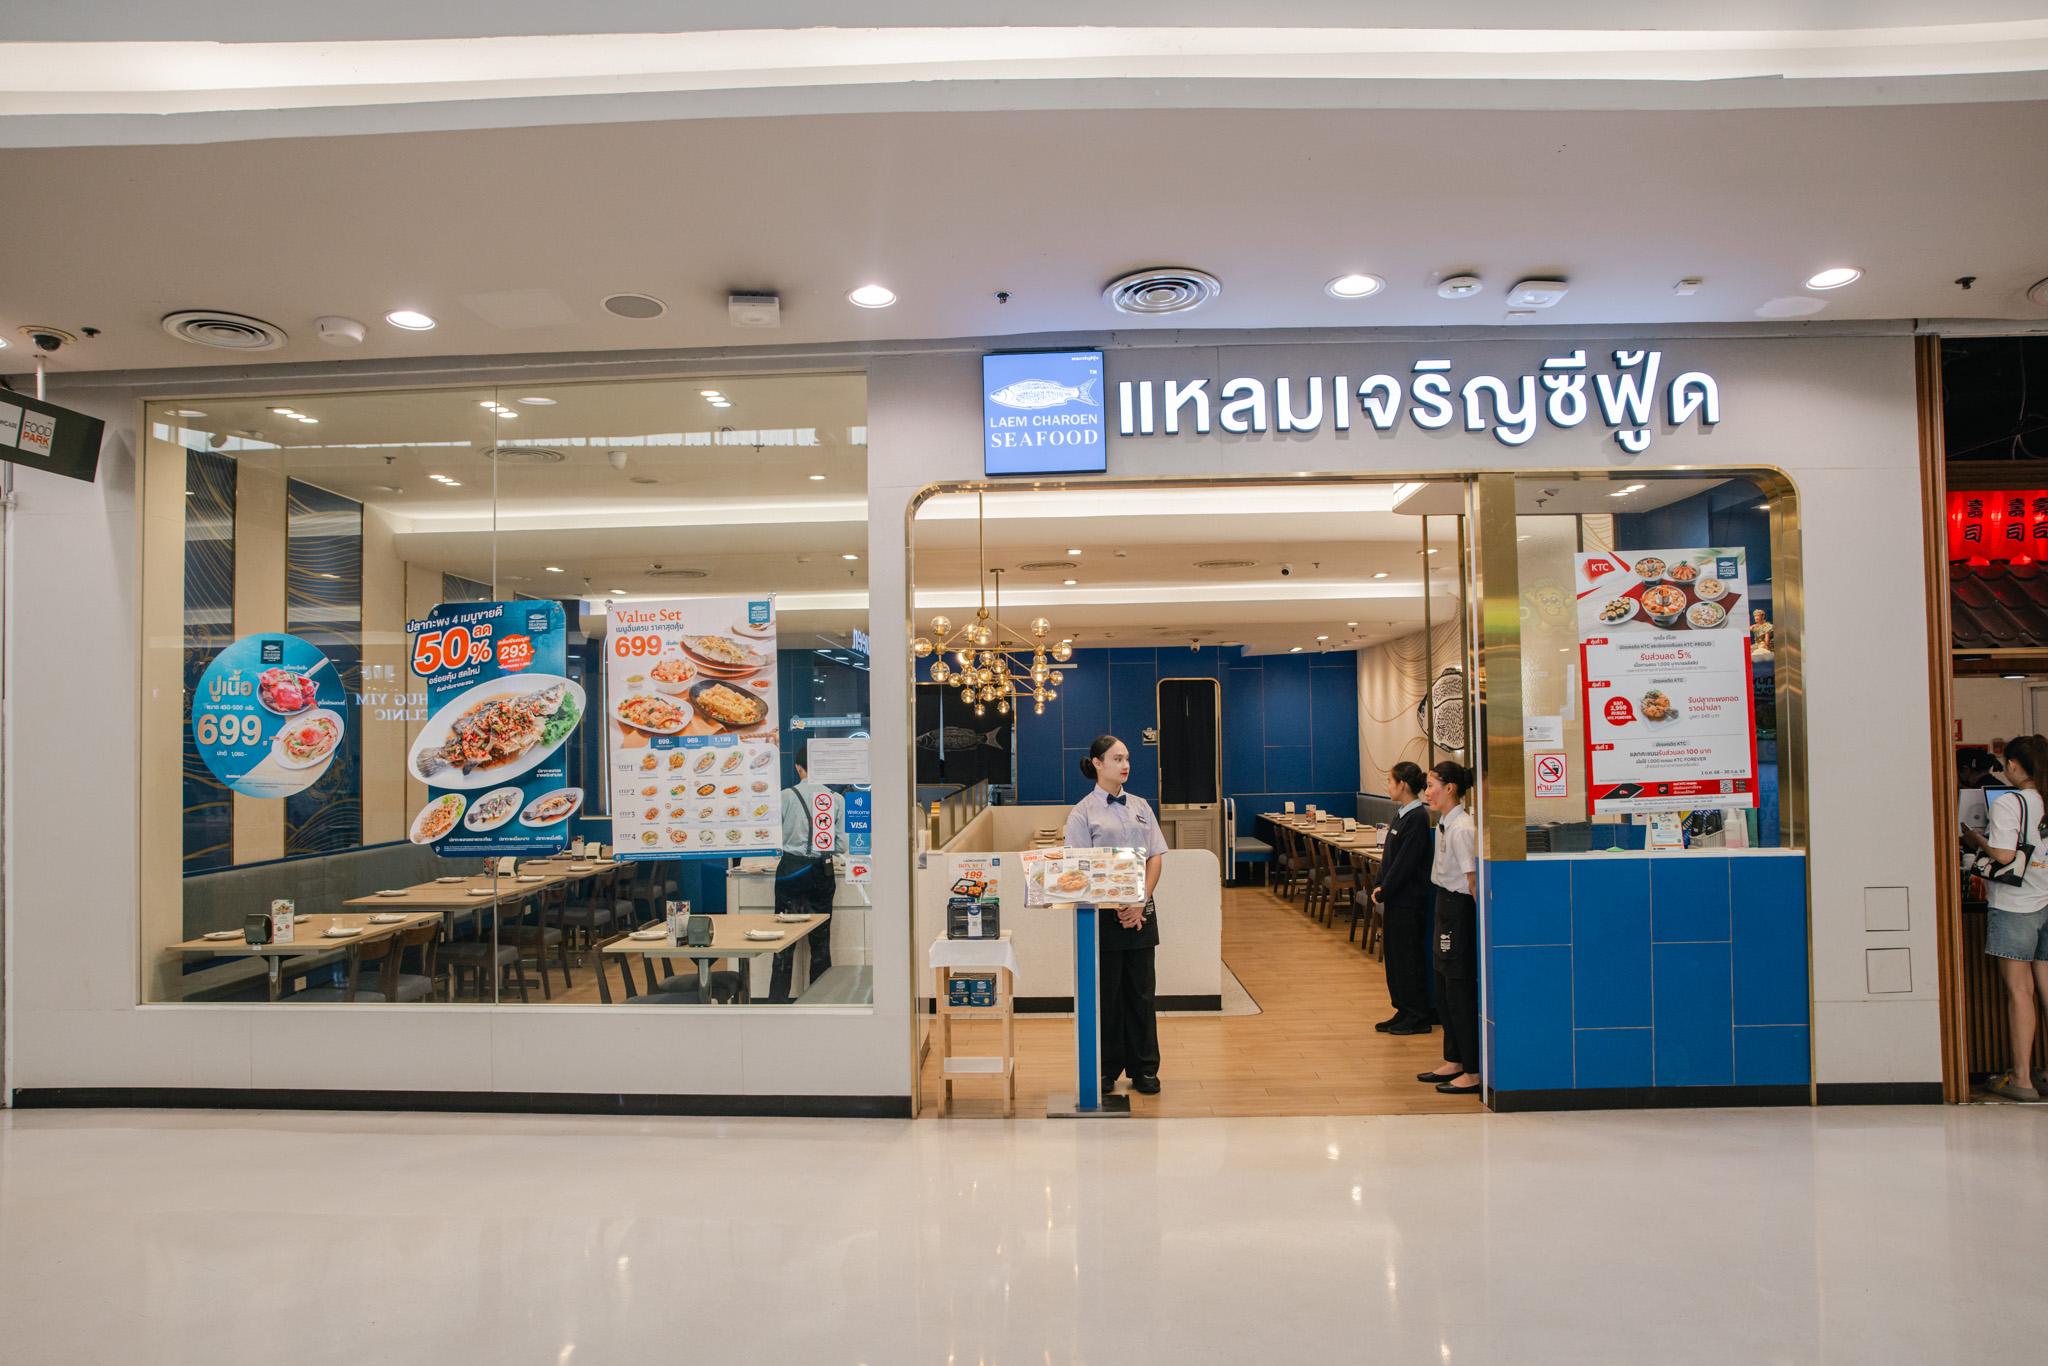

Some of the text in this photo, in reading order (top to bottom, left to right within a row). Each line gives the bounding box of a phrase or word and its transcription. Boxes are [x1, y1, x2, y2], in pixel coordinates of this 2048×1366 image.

[1118, 350, 1721, 453] แหลมเจริญซีฟู้ด
[990, 413, 1098, 428] LAEM CHAROEN
[24, 421, 52, 437] FOOD
[22, 431, 50, 447] PARK
[991, 429, 1098, 448] SEAFOOD
[1591, 564, 1609, 572] KTC
[407, 604, 504, 633] ปลากะพง 4 เมนูขายดี
[616, 608, 682, 624] Value Set
[472, 624, 493, 638] ลด
[616, 621, 684, 635] เมนูอิ่มครบ ราคาสุดคุ้ม
[413, 625, 493, 675] 50%
[500, 643, 535, 660] 293.-
[1640, 649, 1691, 661] รับส่วนลด 5%
[429, 665, 480, 685] อร่อยคุ้ม สดใหม่
[209, 670, 253, 702] ปูเนื้อ
[630, 764, 634, 772] 1
[1537, 783, 1552, 791] ห้าม
[631, 833, 636, 841] 4
